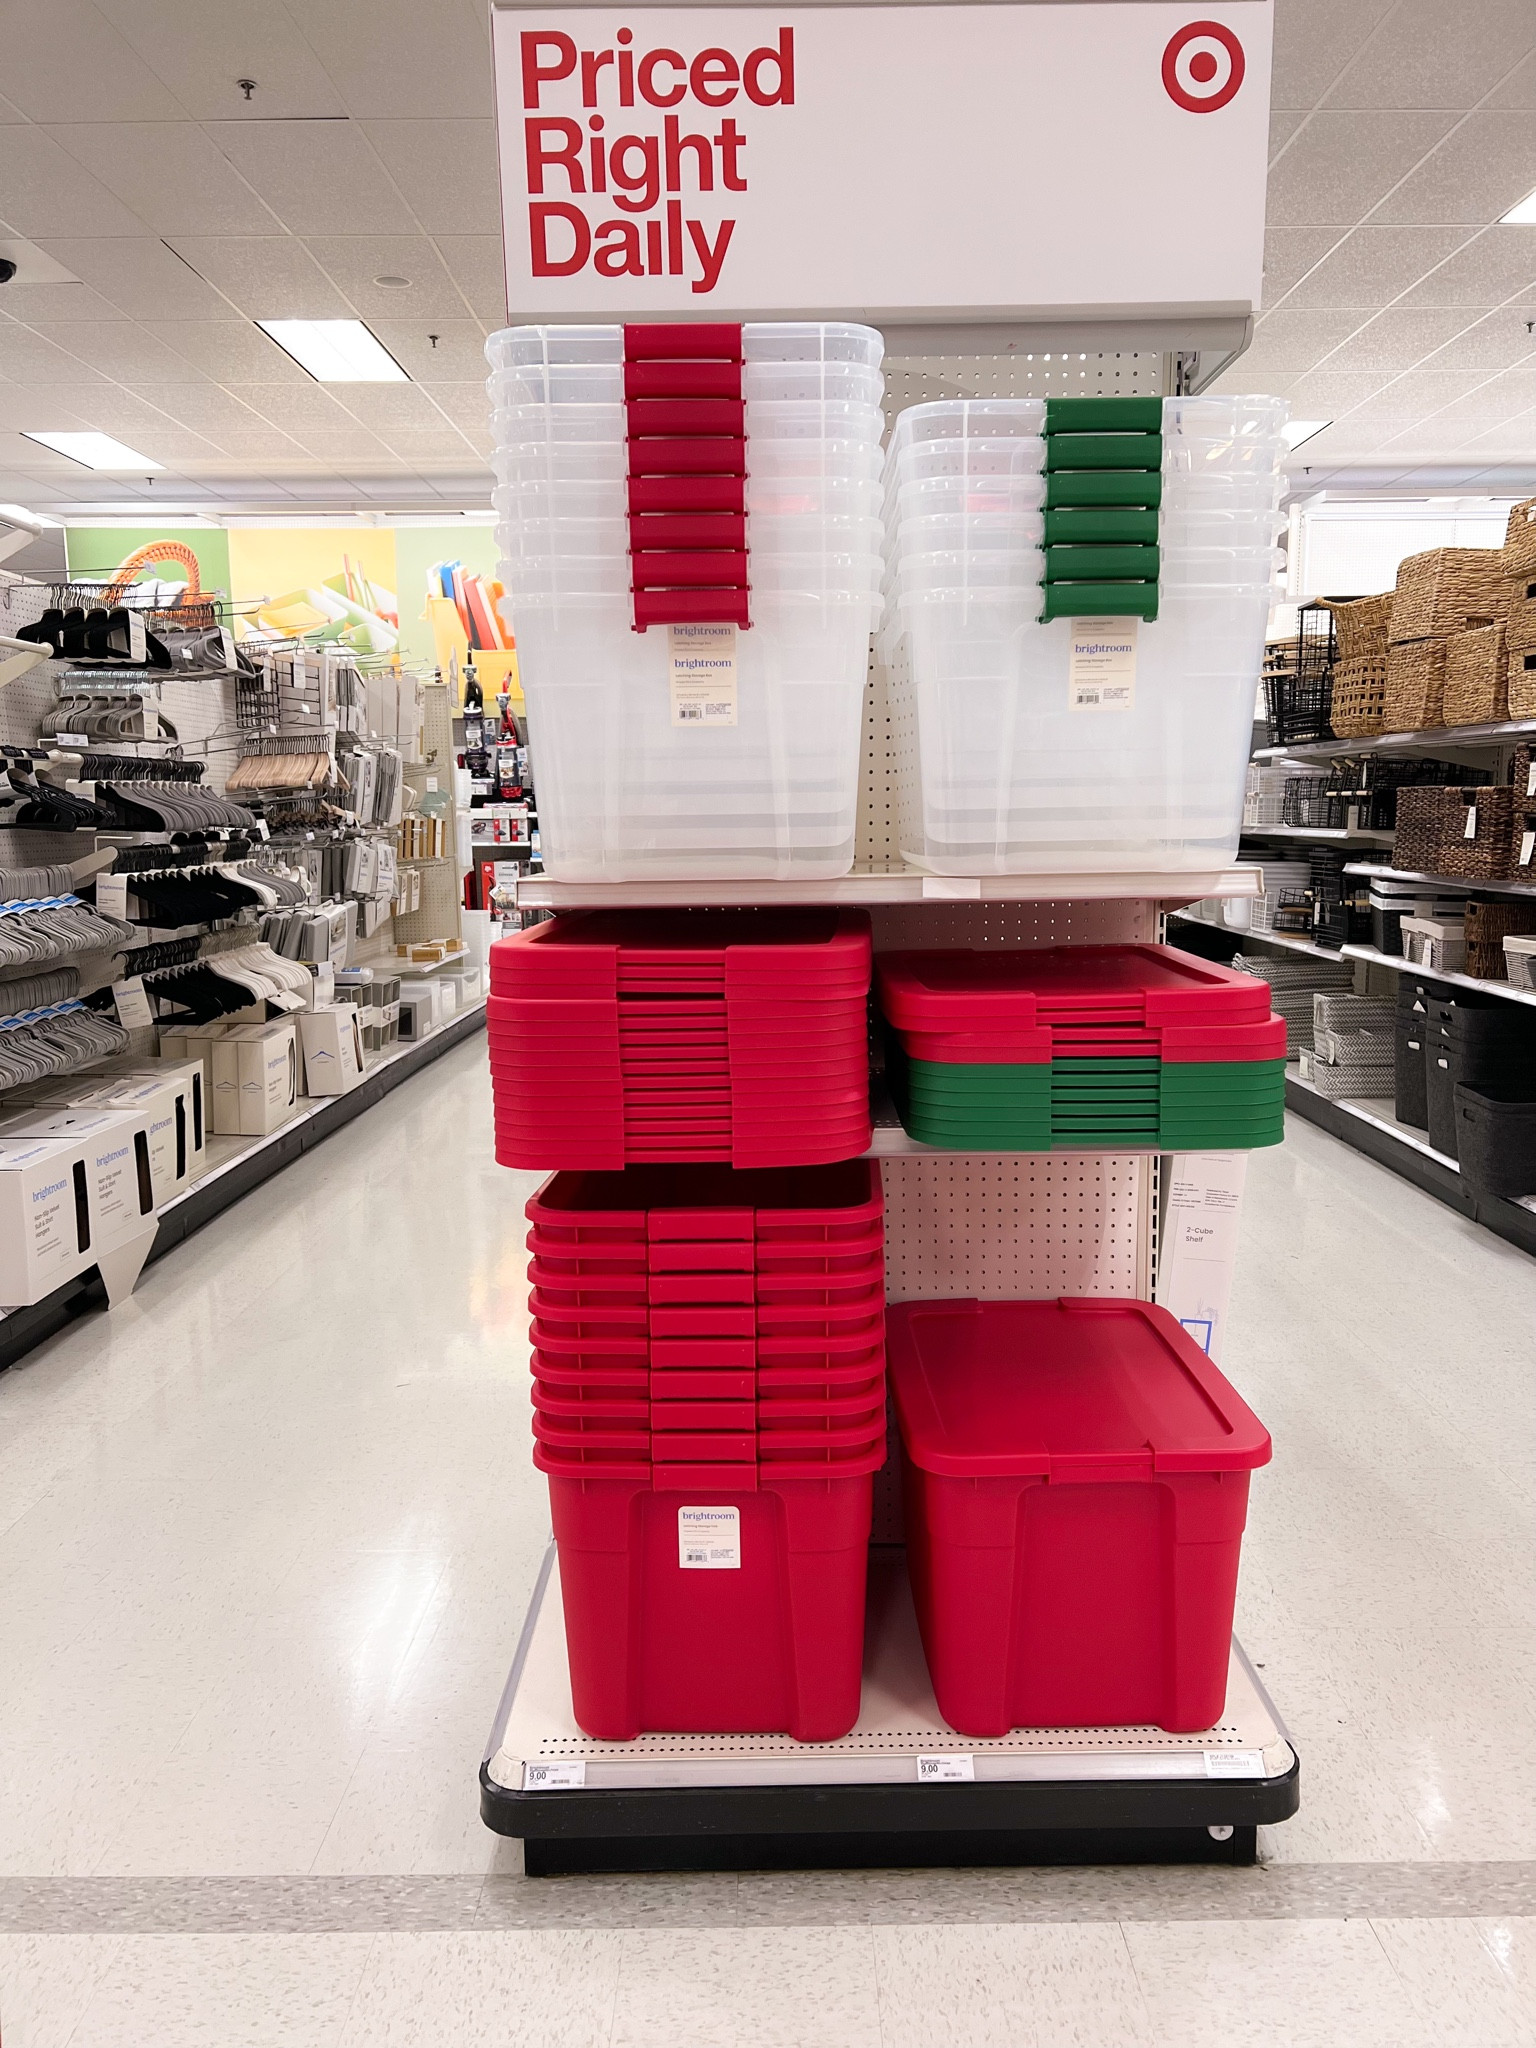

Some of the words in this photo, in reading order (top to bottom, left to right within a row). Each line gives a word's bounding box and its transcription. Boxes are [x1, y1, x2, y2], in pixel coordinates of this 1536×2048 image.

[519, 27, 796, 109] Priced
[524, 114, 748, 213] Right
[529, 199, 736, 294] Daily
[673, 626, 731, 637] brightroom
[1075, 644, 1132, 654] brightroom
[674, 659, 732, 669] brightroom
[150, 1117, 172, 1136] ghtroom
[96, 1147, 129, 1167] brightroom
[32, 1179, 67, 1202] brightroom
[1186, 1226, 1214, 1234] 2-Cube
[682, 1512, 735, 1521] brightroom
[921, 1764, 938, 1773] 9.00
[529, 1771, 547, 1780] 9.00
